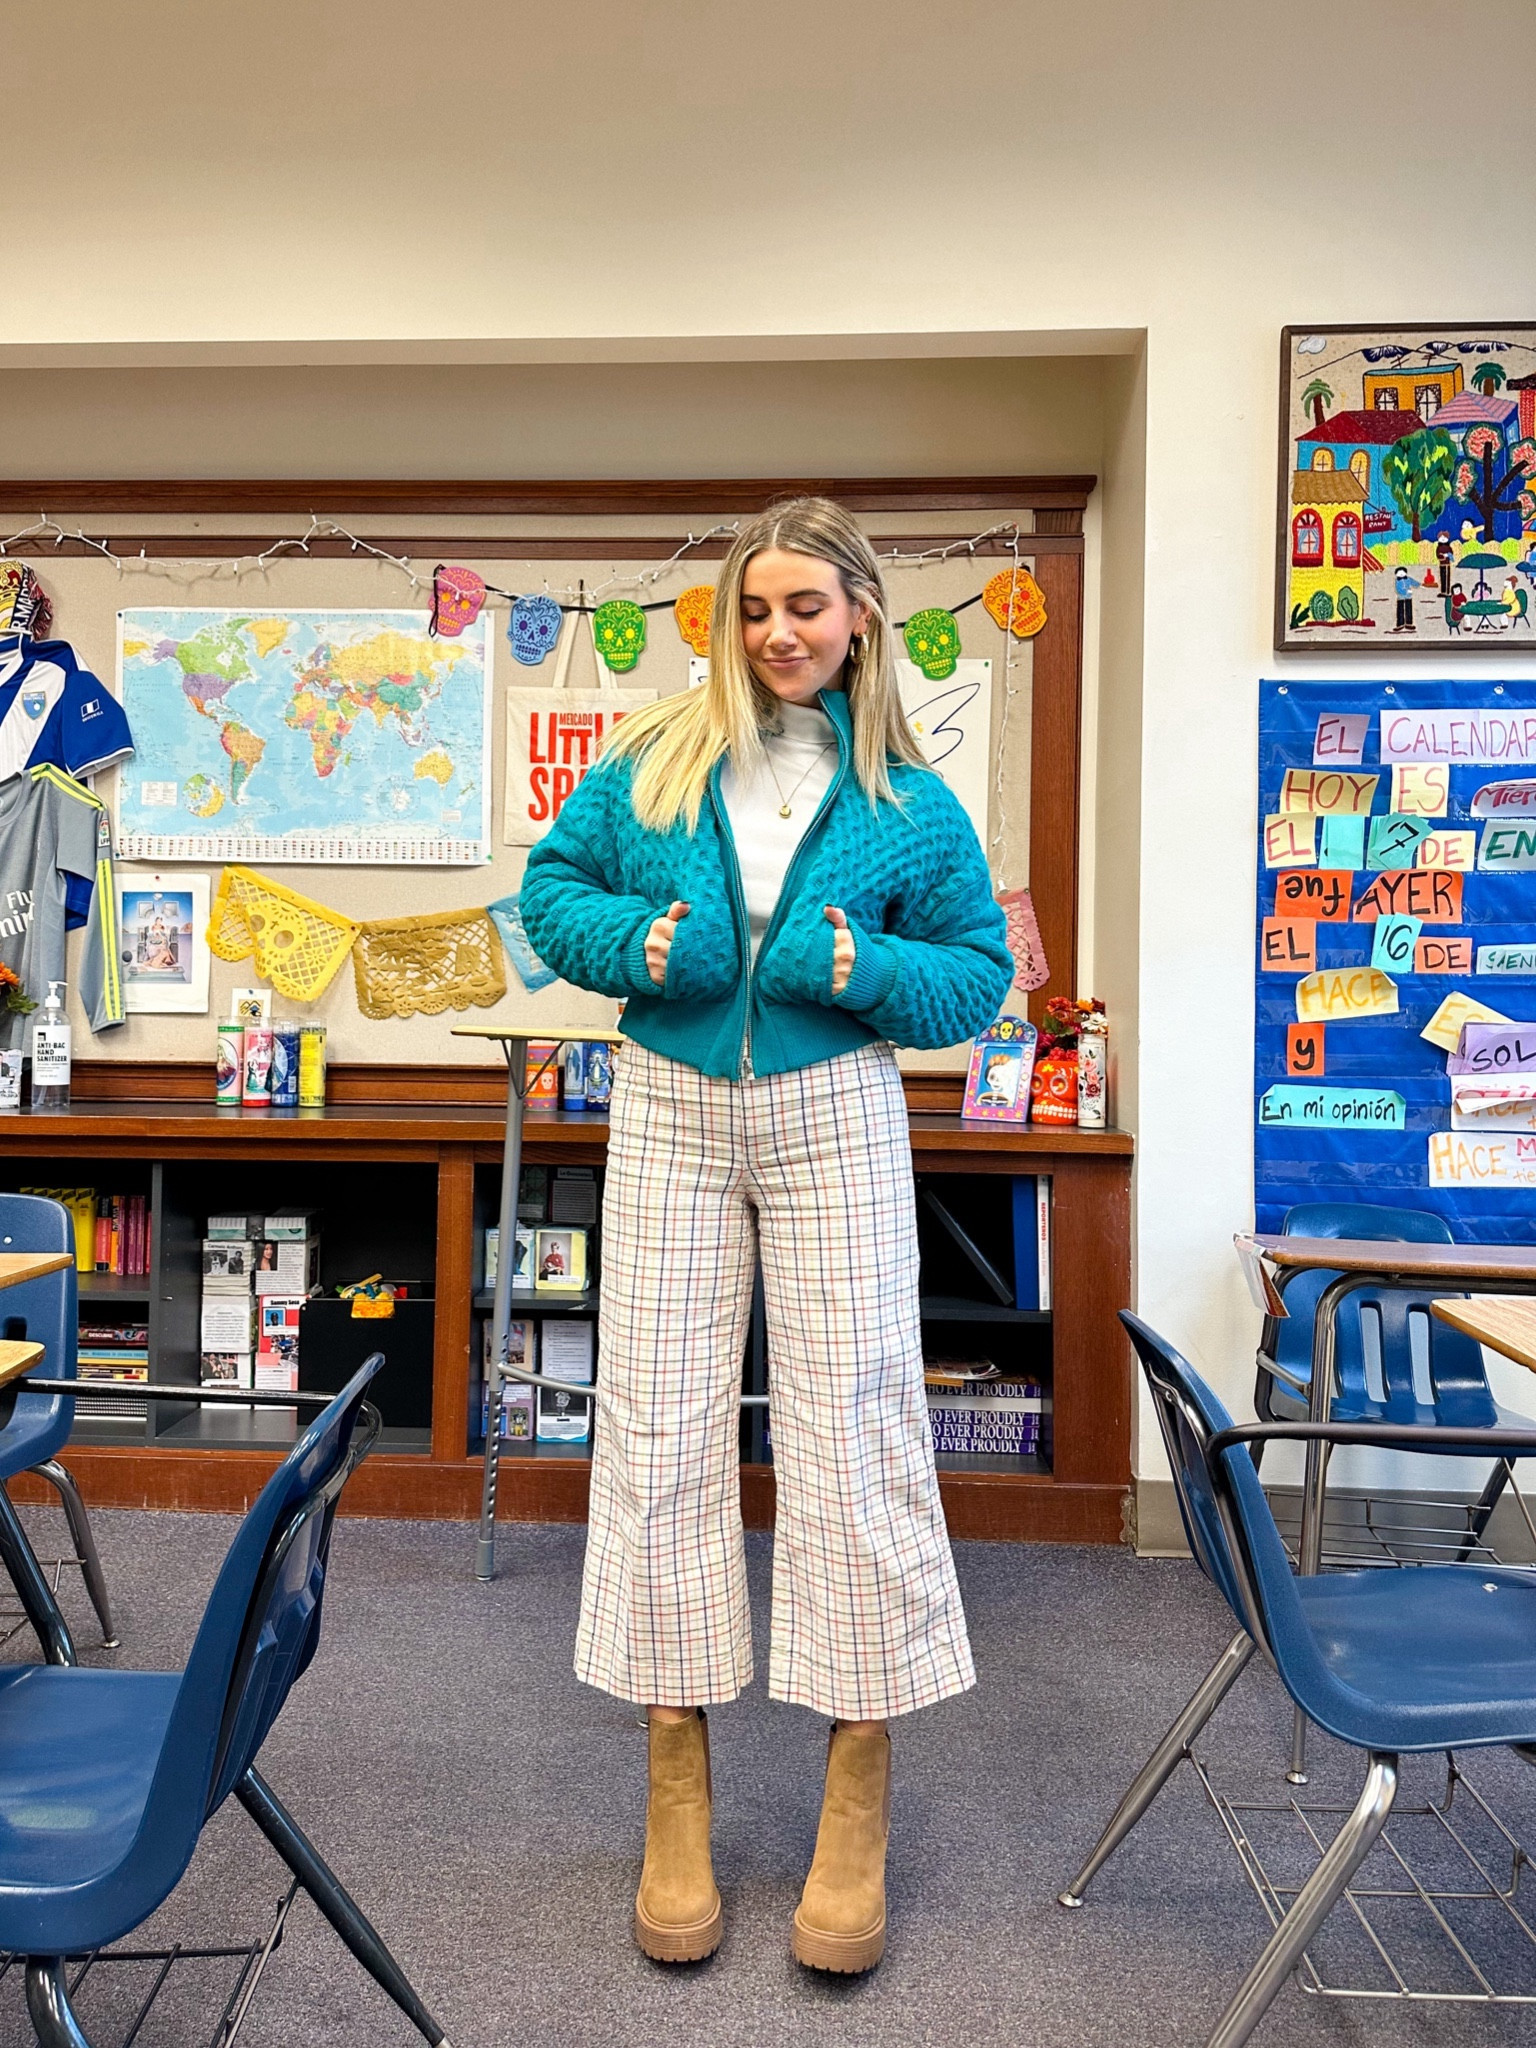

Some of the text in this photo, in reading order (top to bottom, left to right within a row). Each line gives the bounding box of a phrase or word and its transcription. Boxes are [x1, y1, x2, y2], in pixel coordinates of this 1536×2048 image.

[559, 713, 593, 726] MERCADO
[1316, 719, 1360, 756] EL
[1285, 767, 1536, 813] HOY ES Mier
[1266, 819, 1311, 861] EL
[1420, 837, 1465, 866] DE
[1355, 872, 1454, 916] AYER
[1265, 927, 1310, 960] EL
[1423, 943, 1468, 969] DE
[1300, 972, 1393, 1013] HACE
[1261, 1095, 1292, 1121] En
[1332, 1097, 1396, 1123] opinión
[1431, 1134, 1507, 1180] HACE
[947, 1383, 974, 1396] EVER
[976, 1383, 1027, 1398] PROUDLY
[943, 1423, 971, 1438] EVER
[973, 1425, 1024, 1440] PROUDLY
[944, 1410, 972, 1423] EVER
[974, 1411, 1025, 1426] PROUDLY
[941, 1438, 968, 1452] EVER
[971, 1439, 1021, 1453] PROUDLY
